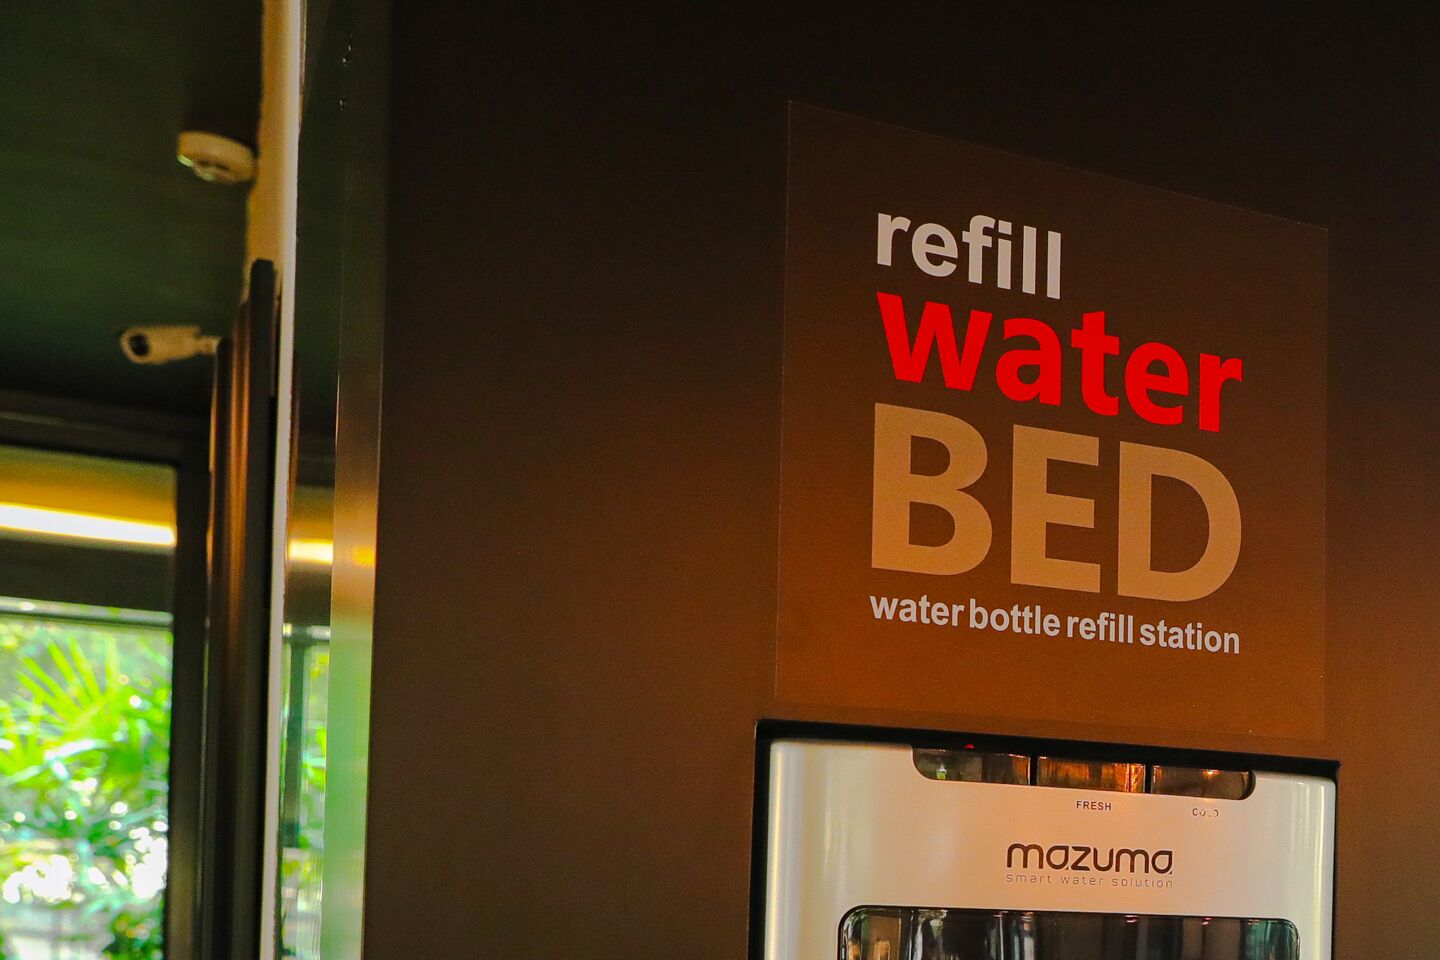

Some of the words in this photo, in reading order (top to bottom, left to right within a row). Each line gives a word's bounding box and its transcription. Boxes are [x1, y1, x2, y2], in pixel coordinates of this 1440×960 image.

[877, 212, 1062, 300] refill
[876, 292, 1243, 433] water
[871, 402, 1242, 602] BED
[869, 594, 965, 627] water
[969, 598, 1061, 637] bottle
[1067, 612, 1134, 644] refill
[1139, 619, 1240, 655] station
[1076, 800, 1112, 811] FRESH
[1192, 808, 1219, 817] COD
[1006, 843, 1173, 875] mazuma
[1006, 873, 1052, 884] smart
[1060, 875, 1104, 886] water
[1111, 878, 1173, 888] solution
